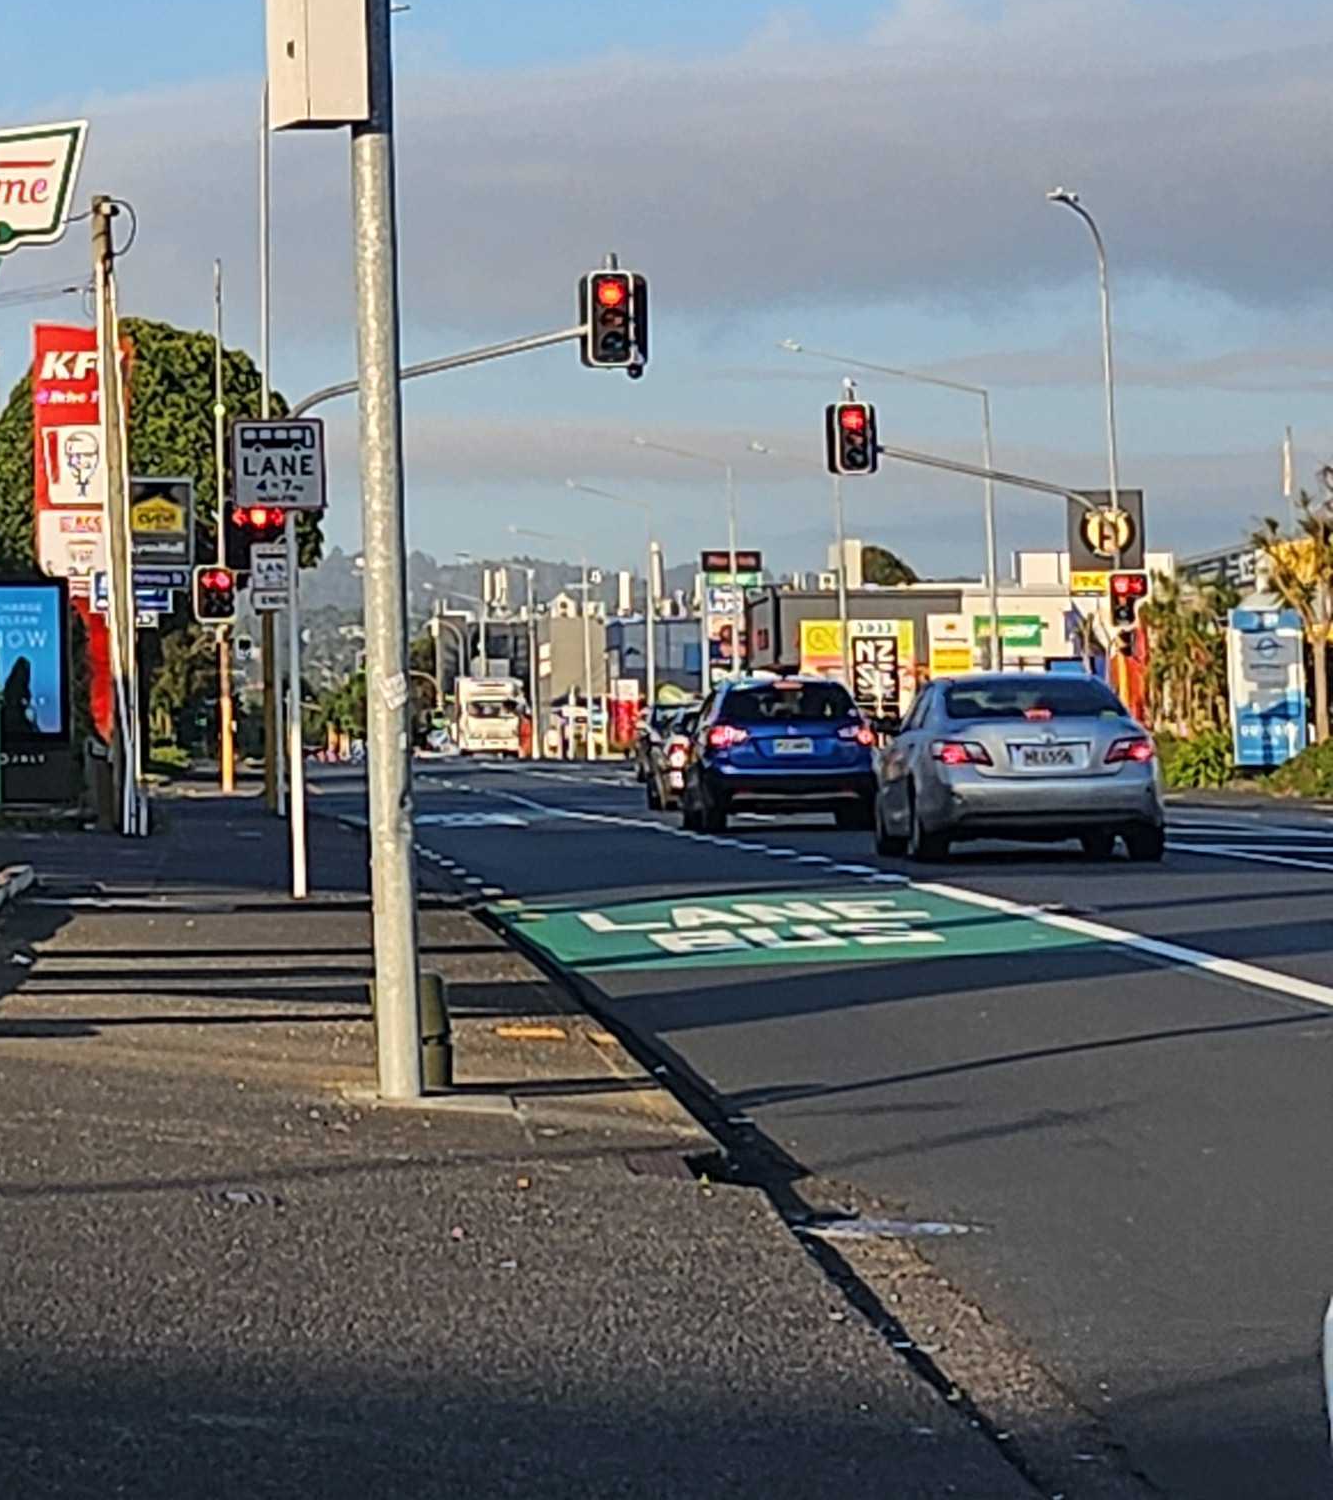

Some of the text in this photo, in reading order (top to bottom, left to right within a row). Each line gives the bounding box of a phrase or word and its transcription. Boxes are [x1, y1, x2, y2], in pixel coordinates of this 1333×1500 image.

[242, 454, 315, 478] LANE
[257, 561, 286, 575] LAN
[855, 639, 896, 663] NZ
[577, 898, 931, 933] LANE
[646, 920, 947, 954] BUS
